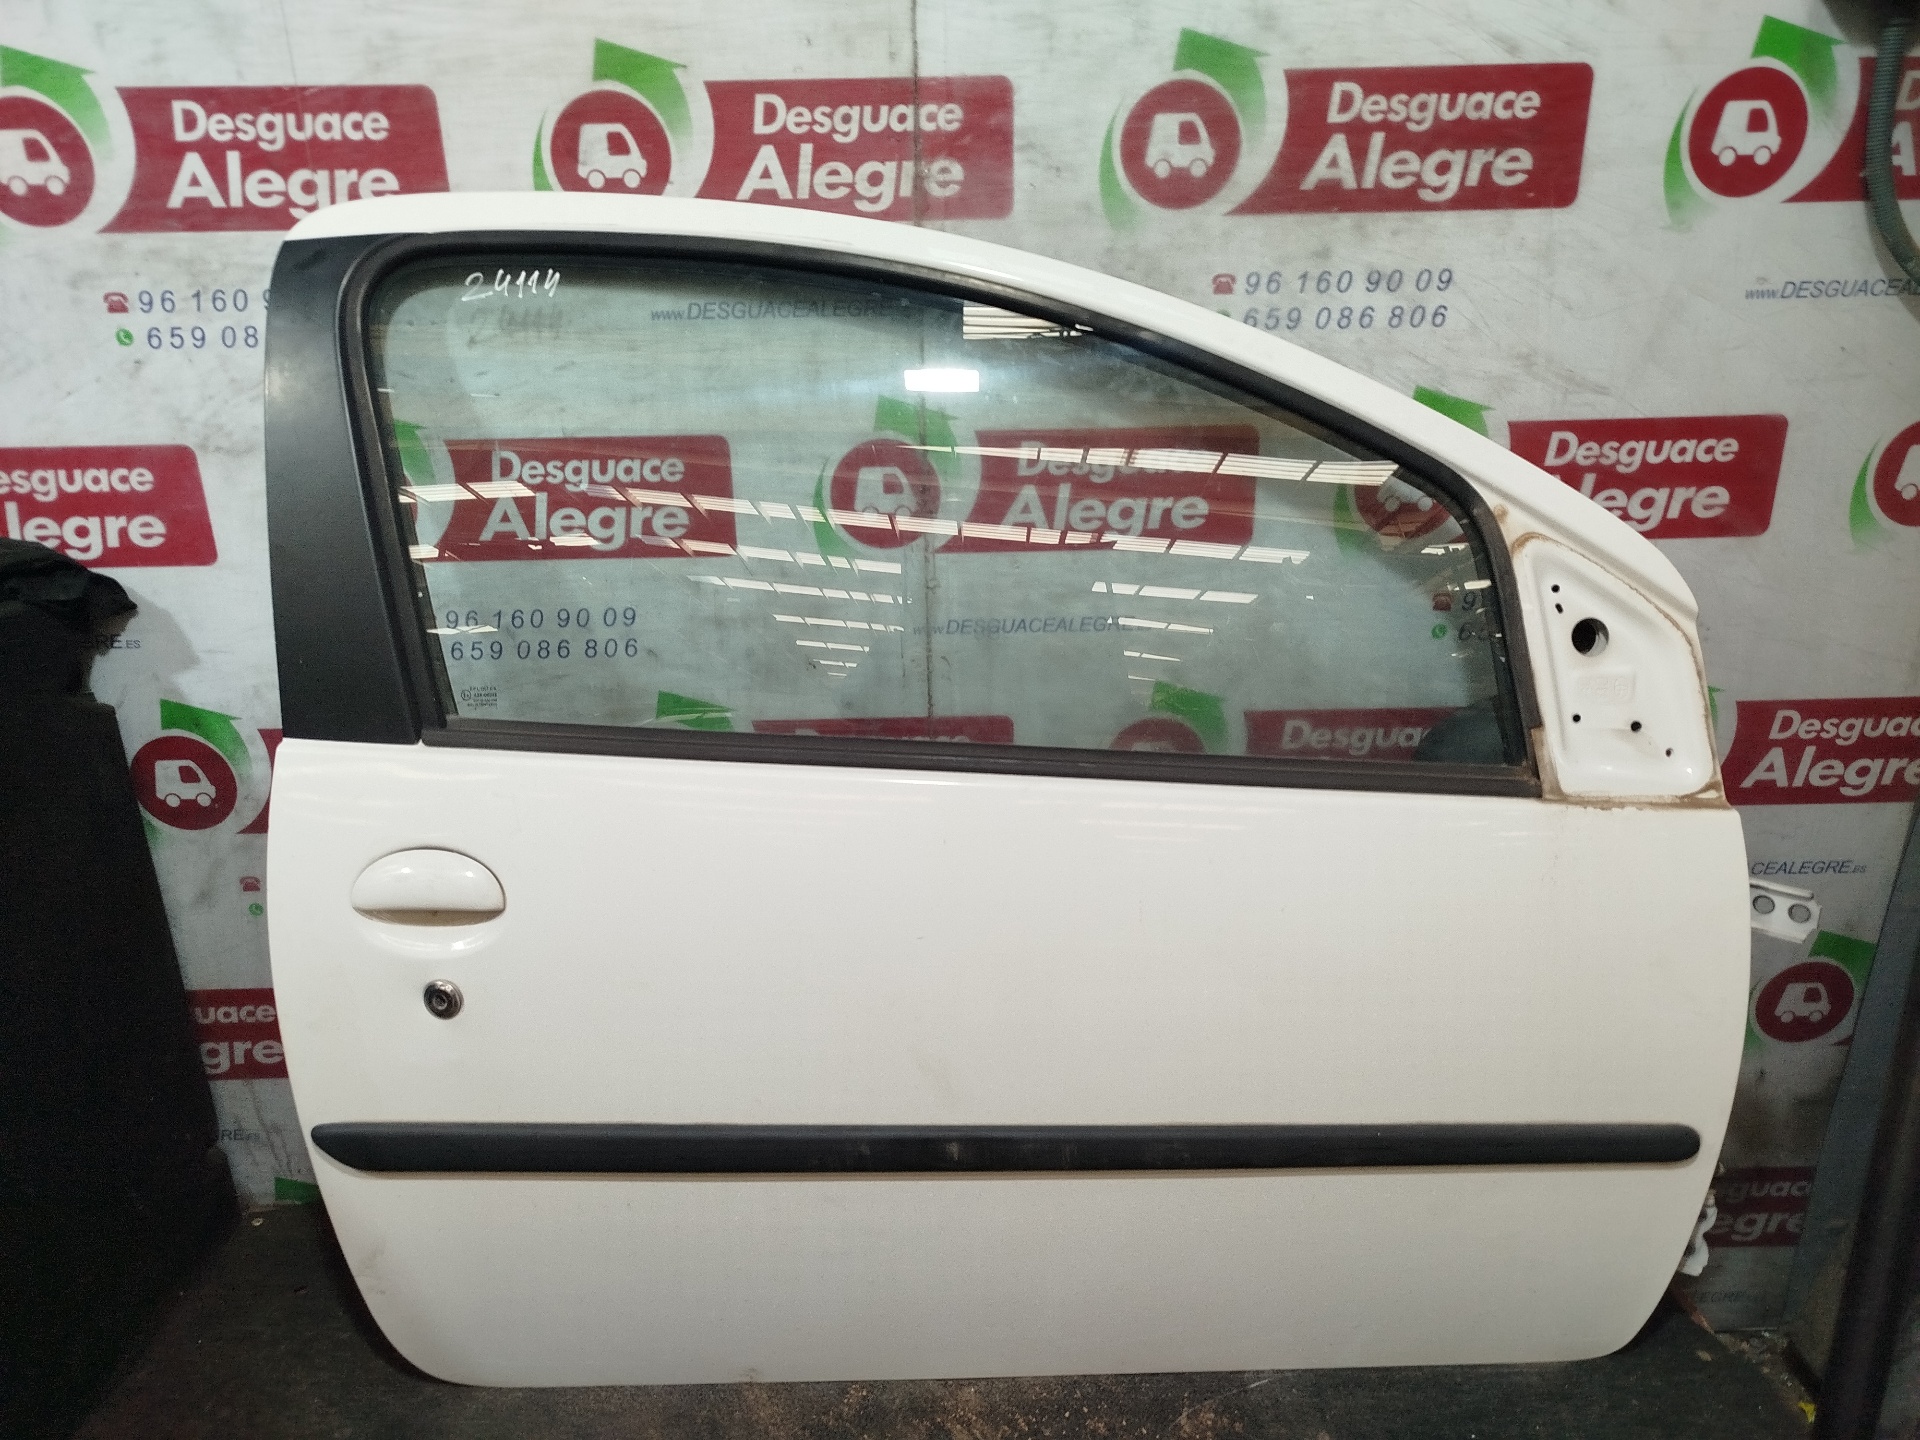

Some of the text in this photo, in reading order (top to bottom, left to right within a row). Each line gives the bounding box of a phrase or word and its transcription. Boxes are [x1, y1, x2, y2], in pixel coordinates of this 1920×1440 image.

[172, 100, 389, 151] Desguace
[753, 93, 964, 143] Desguace
[1327, 82, 1541, 132] Desguace
[167, 151, 399, 218] Alegre
[736, 144, 965, 212] Alegre
[1300, 132, 1533, 202] Alegre
[138, 290, 176, 314] 96
[191, 289, 248, 312] 160
[1245, 268, 1453, 295] 96 160 90 09
[147, 325, 259, 350] 659 08
[1243, 305, 1448, 331] 659 086 806
[491, 450, 685, 493] Desguace
[1544, 430, 1739, 474] Desguace
[479, 492, 690, 551] Alegre
[1001, 482, 1209, 537] Alegre
[1550, 472, 1730, 532] legre
[445, 607, 636, 629] 96 160 90 09
[451, 638, 638, 661] 659 086 806
[1282, 719, 1431, 756] Desgua
